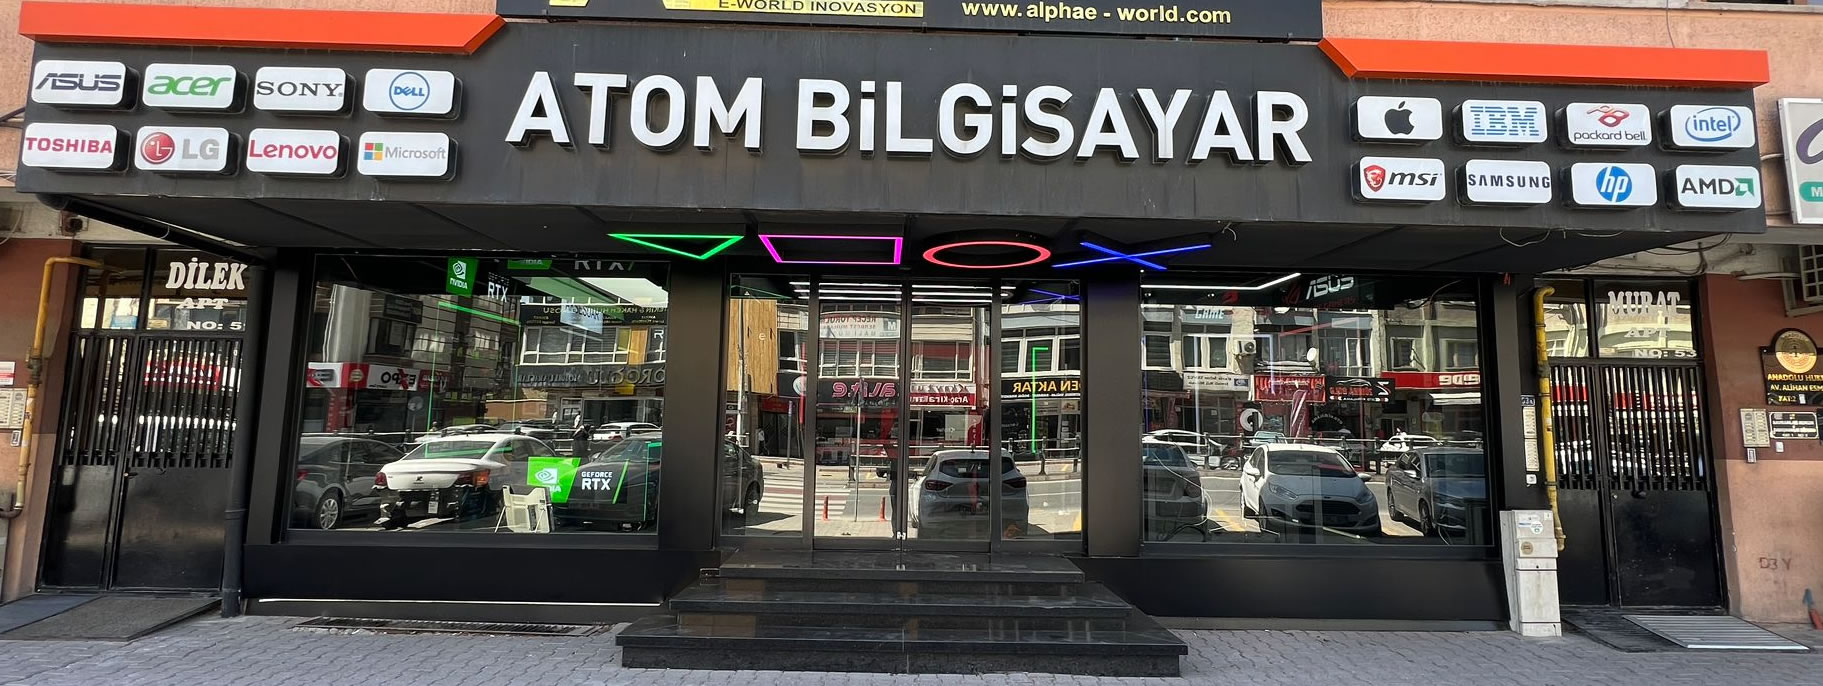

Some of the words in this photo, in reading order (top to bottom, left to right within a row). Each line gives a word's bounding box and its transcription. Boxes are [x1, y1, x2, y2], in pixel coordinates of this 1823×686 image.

[718, 0, 804, 11] E-WORLD
[811, 1, 917, 14] INOVASYON
[35, 72, 122, 92] ASUS
[147, 75, 232, 96] acer
[256, 80, 341, 97] SONY
[393, 85, 425, 98] DELL
[505, 70, 763, 150] ATOM
[1470, 106, 1540, 136] IBM
[1693, 115, 1732, 132] intel
[1573, 129, 1619, 142] packard
[1621, 129, 1647, 141] bell
[26, 136, 113, 154] TOSHIBA
[182, 138, 220, 161] LG
[249, 139, 338, 159] Lenovo
[385, 145, 447, 161] Microsoft
[1388, 170, 1439, 186] msi
[1468, 173, 1551, 189] SAMSUNG
[1601, 166, 1627, 203] hp
[1681, 177, 1734, 195] AMD
[165, 257, 248, 290] DİLEK
[488, 281, 508, 302] RTX
[176, 297, 229, 310] APT
[1608, 291, 1681, 317] MURAT
[186, 321, 223, 330] NO:
[230, 321, 246, 331] 5
[1625, 327, 1671, 338] APT
[1674, 349, 1698, 358] 53
[1767, 373, 1804, 382] ANADOLU
[581, 478, 611, 490] RTX
